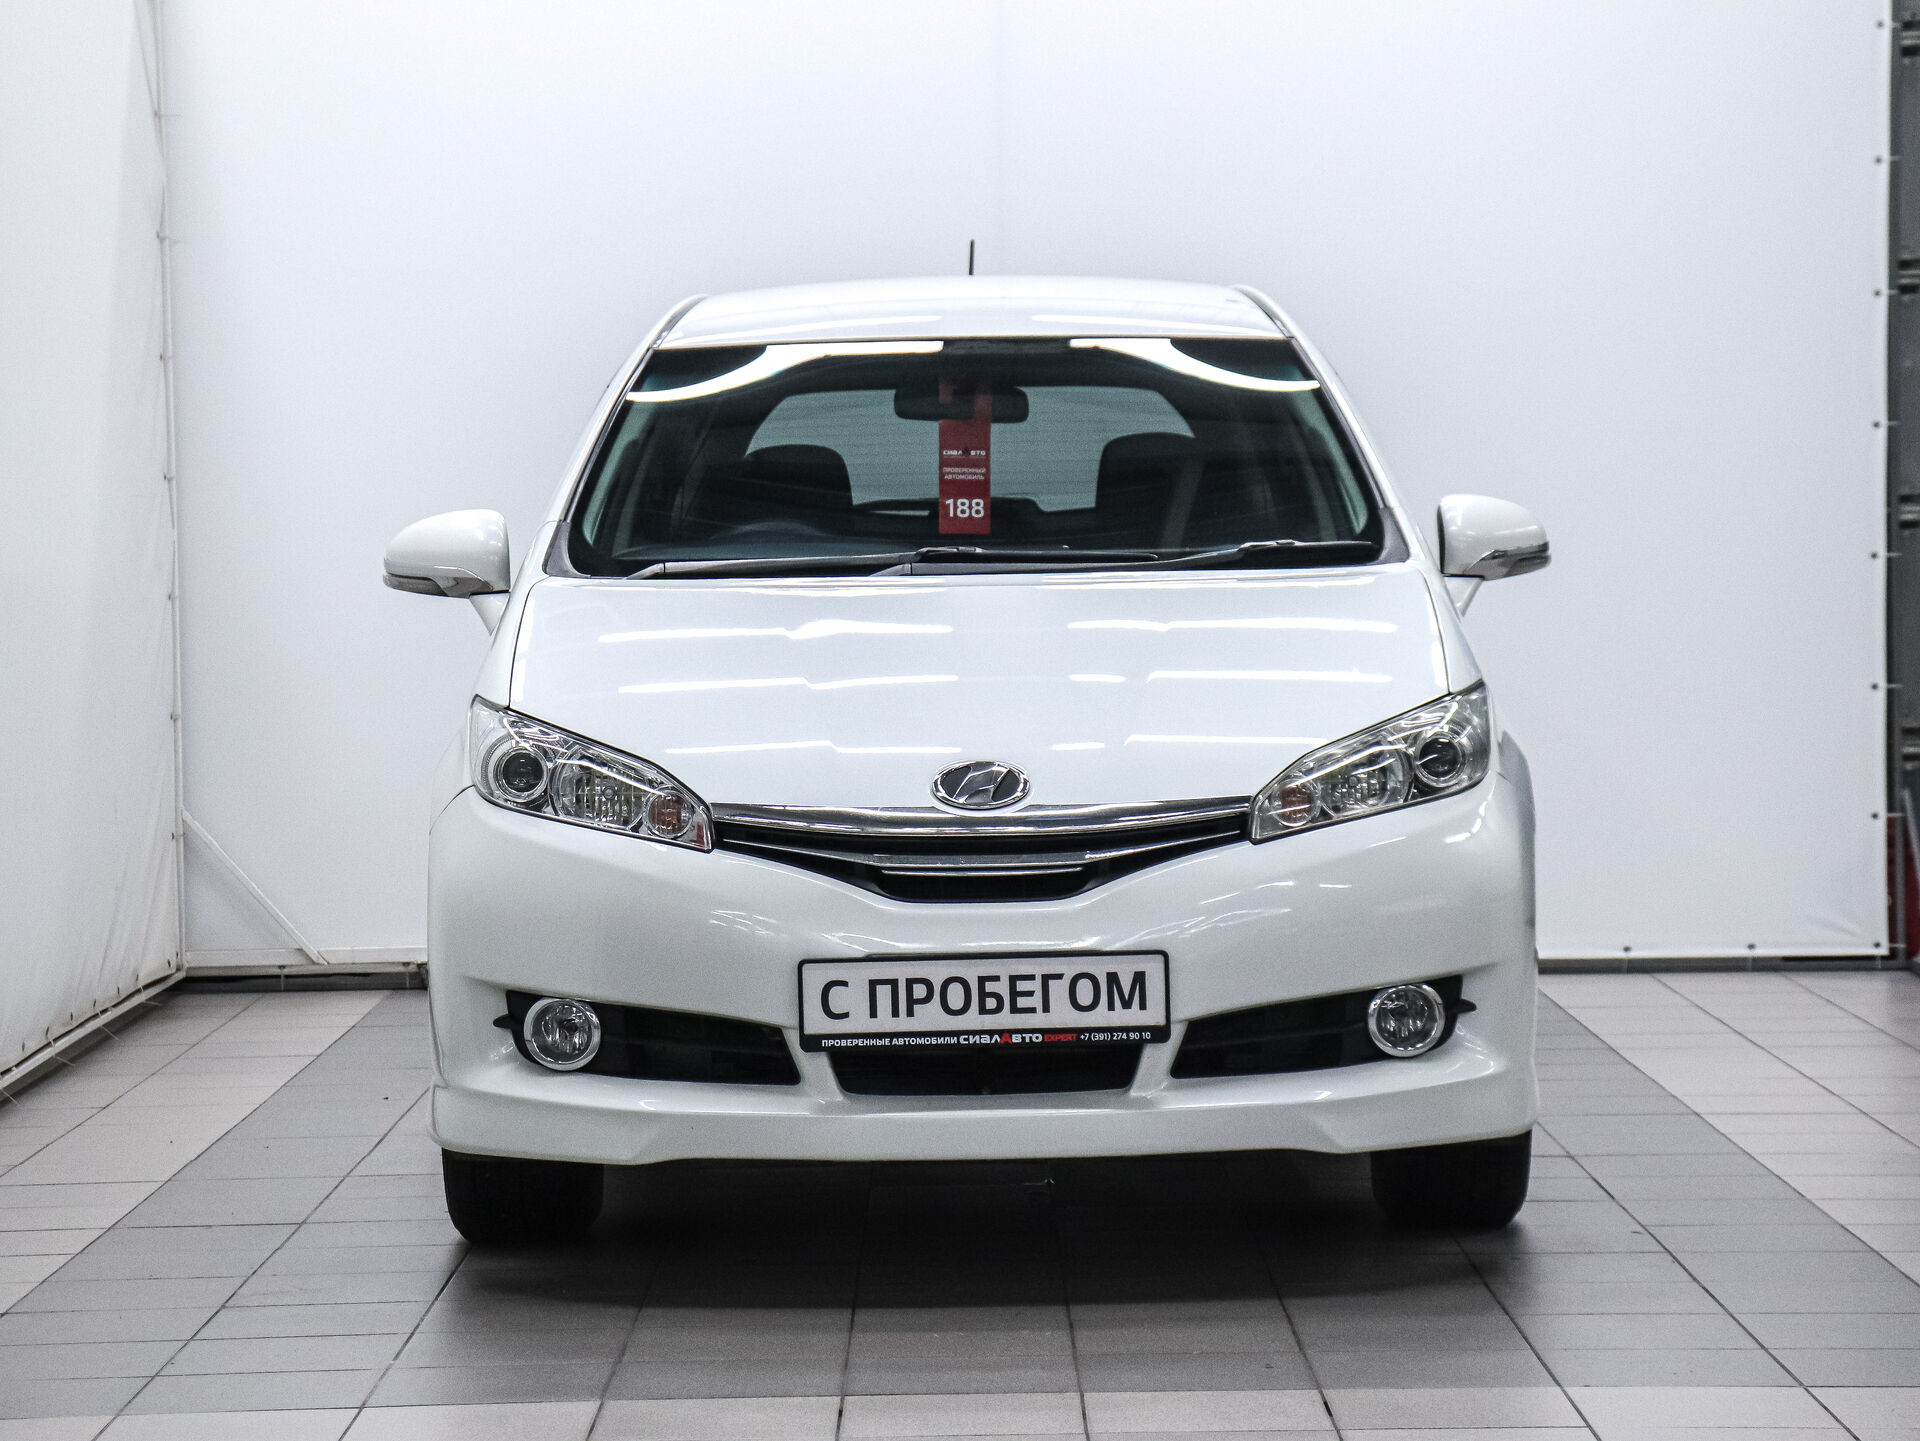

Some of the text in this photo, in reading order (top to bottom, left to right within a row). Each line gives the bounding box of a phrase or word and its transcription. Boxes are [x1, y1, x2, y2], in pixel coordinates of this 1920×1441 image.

[945, 498, 984, 518] 188
[820, 971, 1148, 1020] С ПРОБЕГОМ
[821, 1038, 891, 1047] ПРОВЕРЕННЫЕ
[892, 1036, 958, 1045] АВТОМОБИЛИ
[1044, 1033, 1078, 1041] EXPERT
[1080, 1033, 1089, 1041] +7
[1091, 1032, 1111, 1041] (391)
[1113, 1032, 1127, 1040] 274
[1129, 1032, 1140, 1040] 90
[1142, 1032, 1151, 1040] 10
